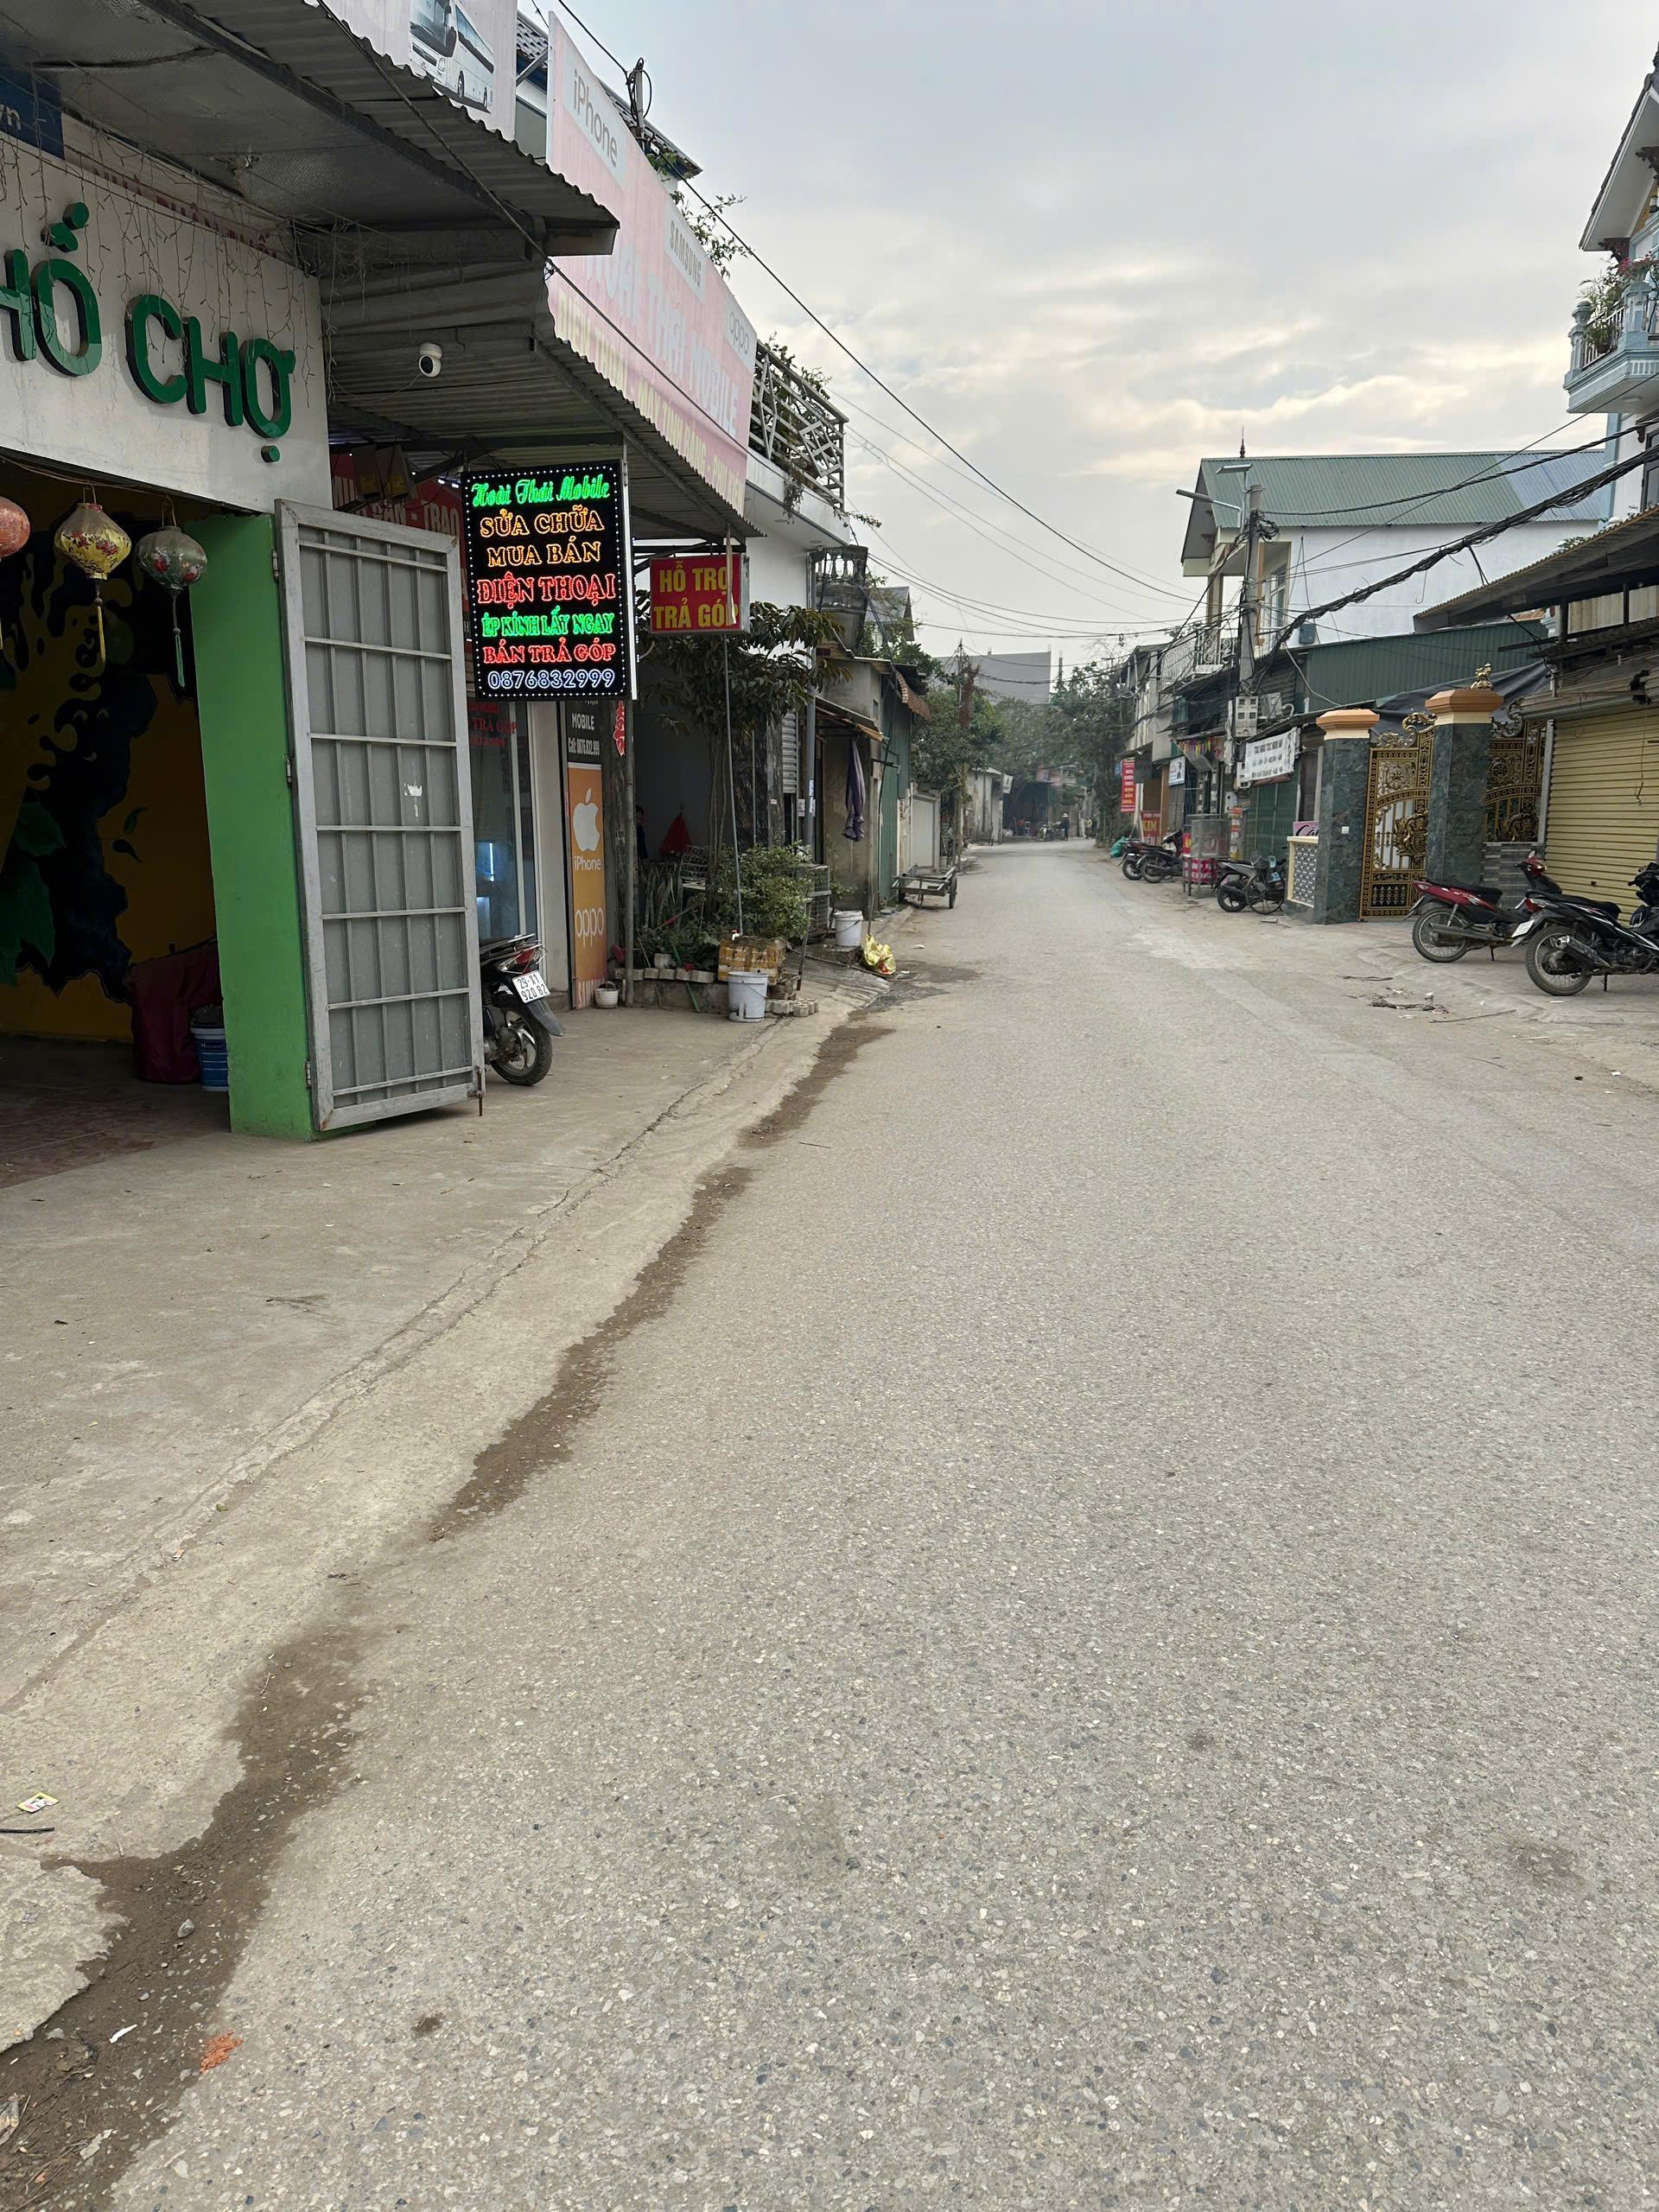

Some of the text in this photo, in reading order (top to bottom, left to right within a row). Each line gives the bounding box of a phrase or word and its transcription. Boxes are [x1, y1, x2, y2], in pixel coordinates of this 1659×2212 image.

[573, 69, 619, 168] iPhone
[670, 220, 702, 287] SAMSUNG
[730, 310, 750, 356] oppo
[125, 295, 296, 463] CHỢ
[515, 479, 554, 505] Thái
[556, 473, 611, 501] Mobile
[480, 505, 605, 537] SỬA CHỮA
[486, 536, 601, 568] MUA BÁN
[476, 572, 535, 610] ĐIỆN
[537, 574, 616, 607] THOẠI
[659, 560, 686, 593] HỖ
[481, 605, 615, 638] ÉP KÍNH LẤY NGAY
[653, 597, 691, 629] TRẢ
[483, 636, 616, 664] BÁN TRẢ GÓP
[487, 668, 615, 690] 0876832999
[571, 712, 595, 731] MOBILE
[574, 855, 601, 871] iPhone
[575, 907, 605, 947] oppo
[518, 974, 540, 988] 29-X1
[521, 983, 548, 1001] 920 82
